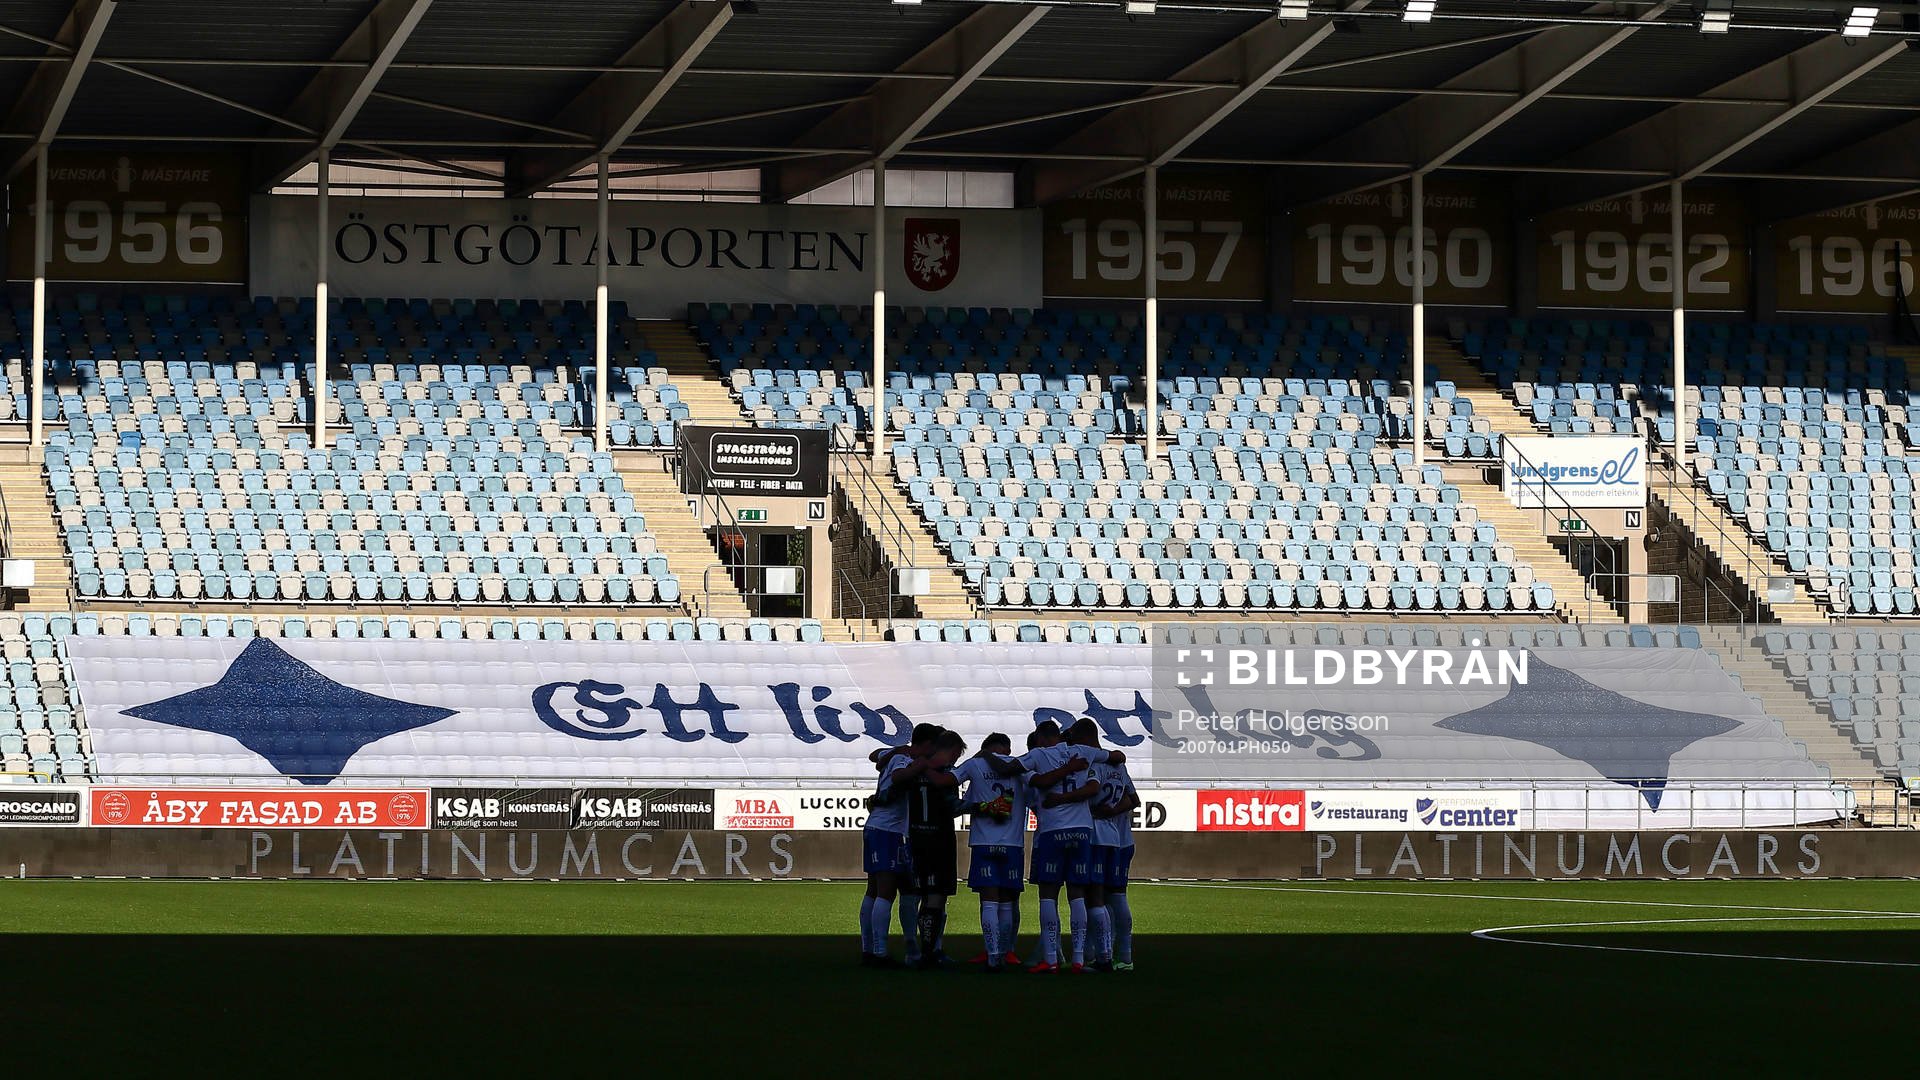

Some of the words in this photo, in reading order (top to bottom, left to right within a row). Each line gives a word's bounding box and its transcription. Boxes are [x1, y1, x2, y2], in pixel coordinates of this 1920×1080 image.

[1652, 199, 1715, 216] MÄTARE
[335, 212, 866, 272] ÖSTGÖTAPORTEN
[1061, 217, 1244, 283] 1957
[1306, 222, 1494, 289] 1960
[1549, 229, 1731, 295] 1962
[716, 442, 794, 455] SVAGSTRÖMS
[716, 455, 793, 466] INSTALLATIONER
[1511, 461, 1598, 481] lundgrens
[707, 479, 735, 488] ANTENN
[740, 480, 756, 489] TELE
[760, 480, 780, 490] FIBER
[785, 481, 804, 490] DATA
[1572, 488, 1604, 497] modern
[810, 503, 823, 518] N
[1627, 512, 1639, 527] N
[143, 792, 213, 823] ÅBY
[220, 801, 323, 824] FASAD
[334, 801, 377, 824] AB
[437, 798, 500, 818] KSAB
[508, 801, 570, 813] KONSTGRÄS
[580, 798, 642, 818] KSAB
[651, 801, 712, 813] KONSTGRÄS
[735, 799, 781, 814] MBA
[1202, 797, 1301, 825] nistra
[1328, 808, 1408, 822] restaurang
[452, 819, 481, 828] naturligt
[500, 819, 518, 827] helst
[594, 819, 623, 828] naturligt
[642, 819, 660, 827] helst
[1440, 807, 1518, 826] center
[252, 831, 795, 876] PLATINUMCARS
[1316, 833, 1821, 876] PLATINUMCARS
